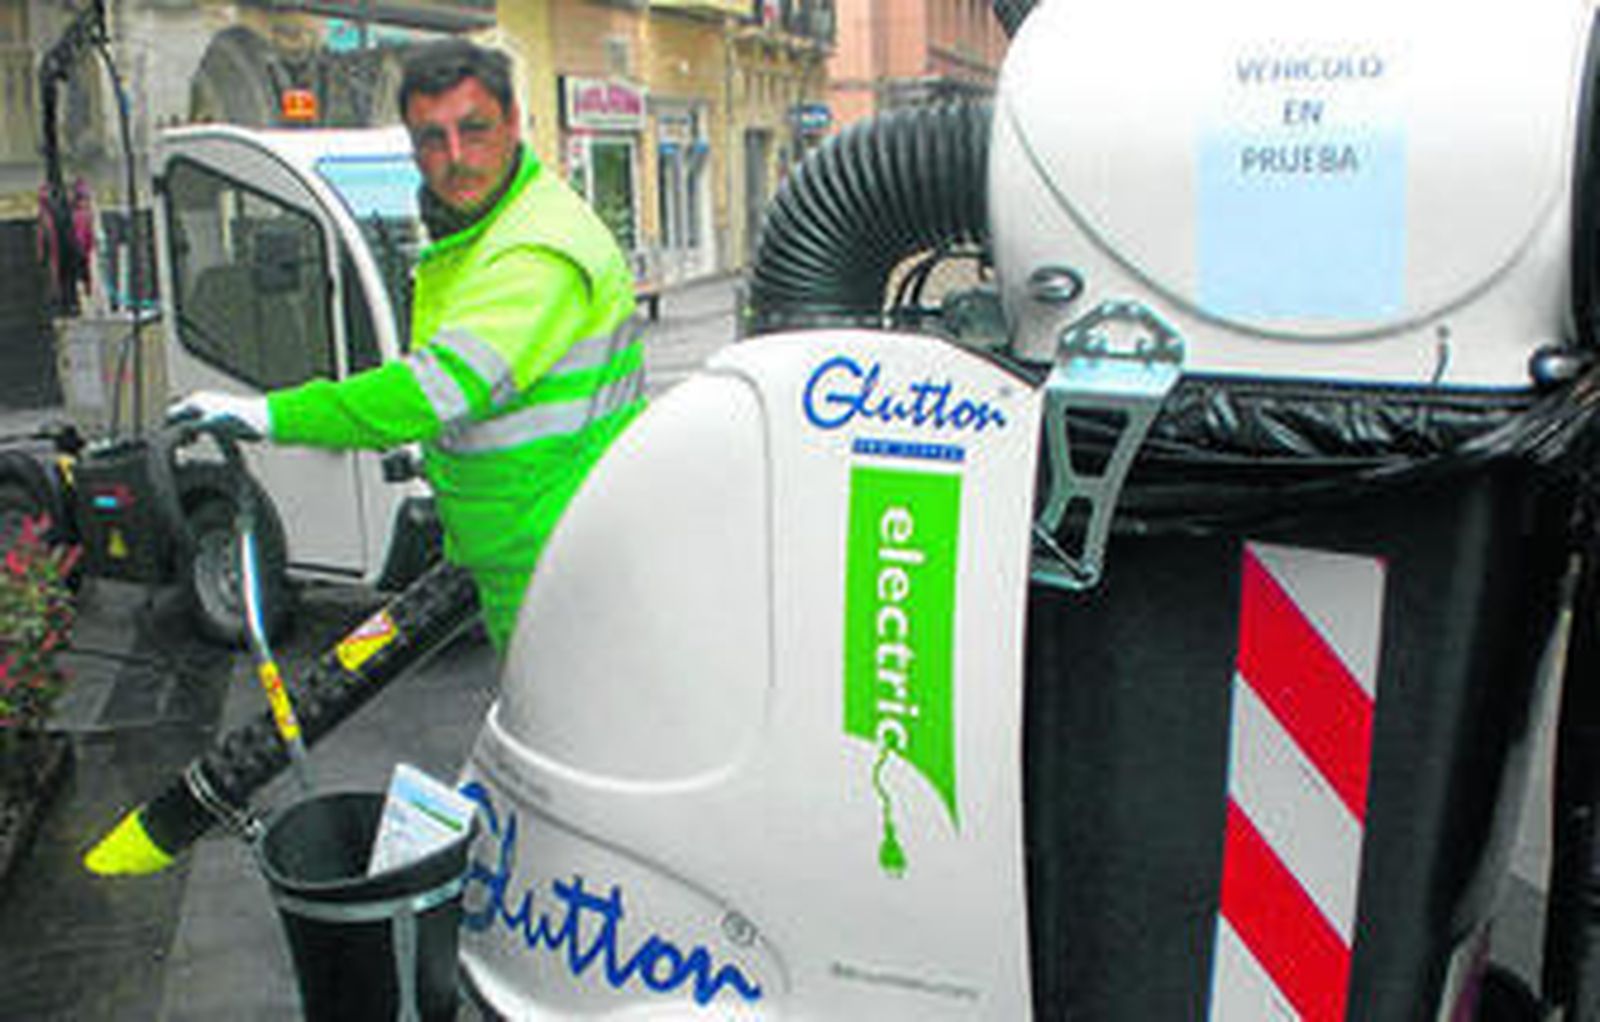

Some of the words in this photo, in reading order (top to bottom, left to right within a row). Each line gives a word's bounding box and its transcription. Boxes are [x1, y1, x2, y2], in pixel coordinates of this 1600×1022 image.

[1283, 98, 1325, 126] EN
[1240, 144, 1360, 175] PRUEBA
[802, 355, 1006, 431] Glutton
[876, 506, 925, 752] electric
